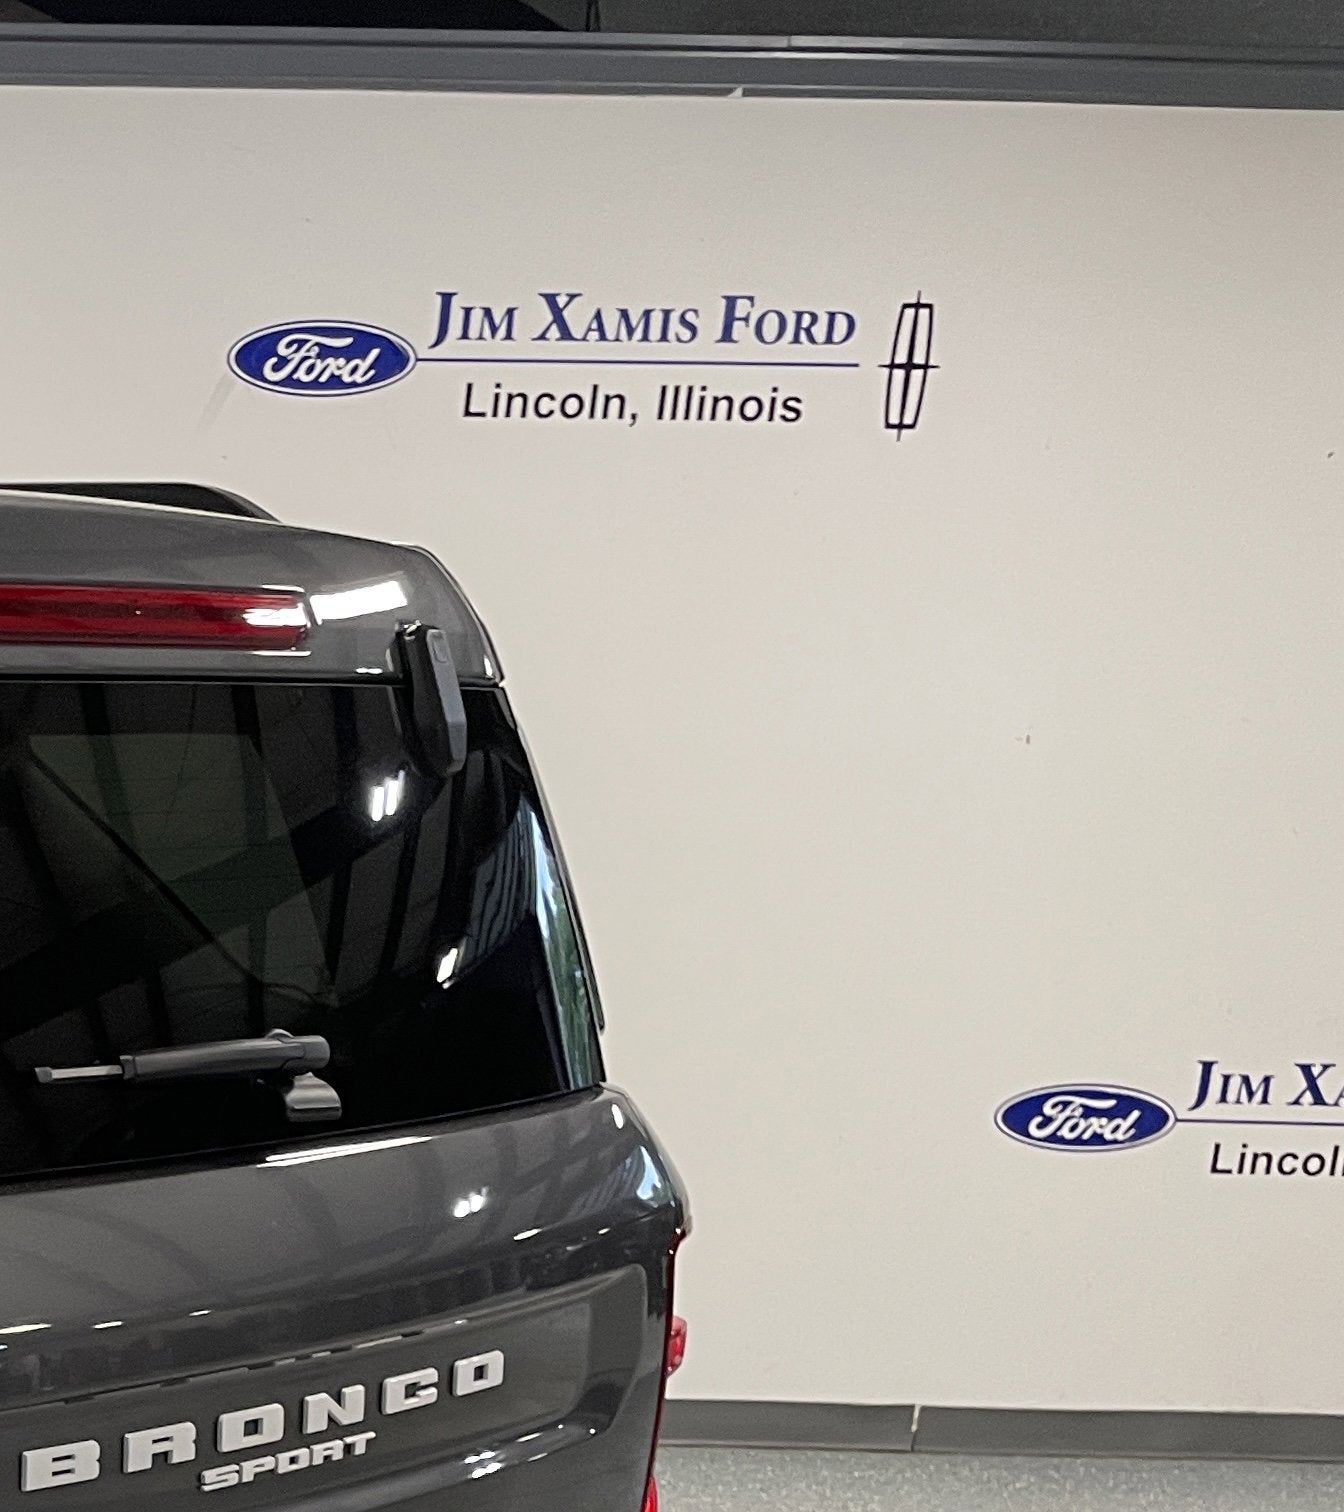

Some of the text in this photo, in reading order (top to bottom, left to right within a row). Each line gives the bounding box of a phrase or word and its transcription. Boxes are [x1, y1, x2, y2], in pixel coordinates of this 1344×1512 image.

[427, 291, 857, 351] JIM XAMIS FORD
[263, 334, 379, 385] Ford
[461, 382, 804, 427] Lincoln, Illinois
[1186, 1059, 1276, 1112] JIM
[1027, 1094, 1143, 1142] Ford
[1209, 1141, 1344, 1177] Lincol
[20, 1349, 505, 1492] BRONCO
[199, 1431, 377, 1492] SPORT
